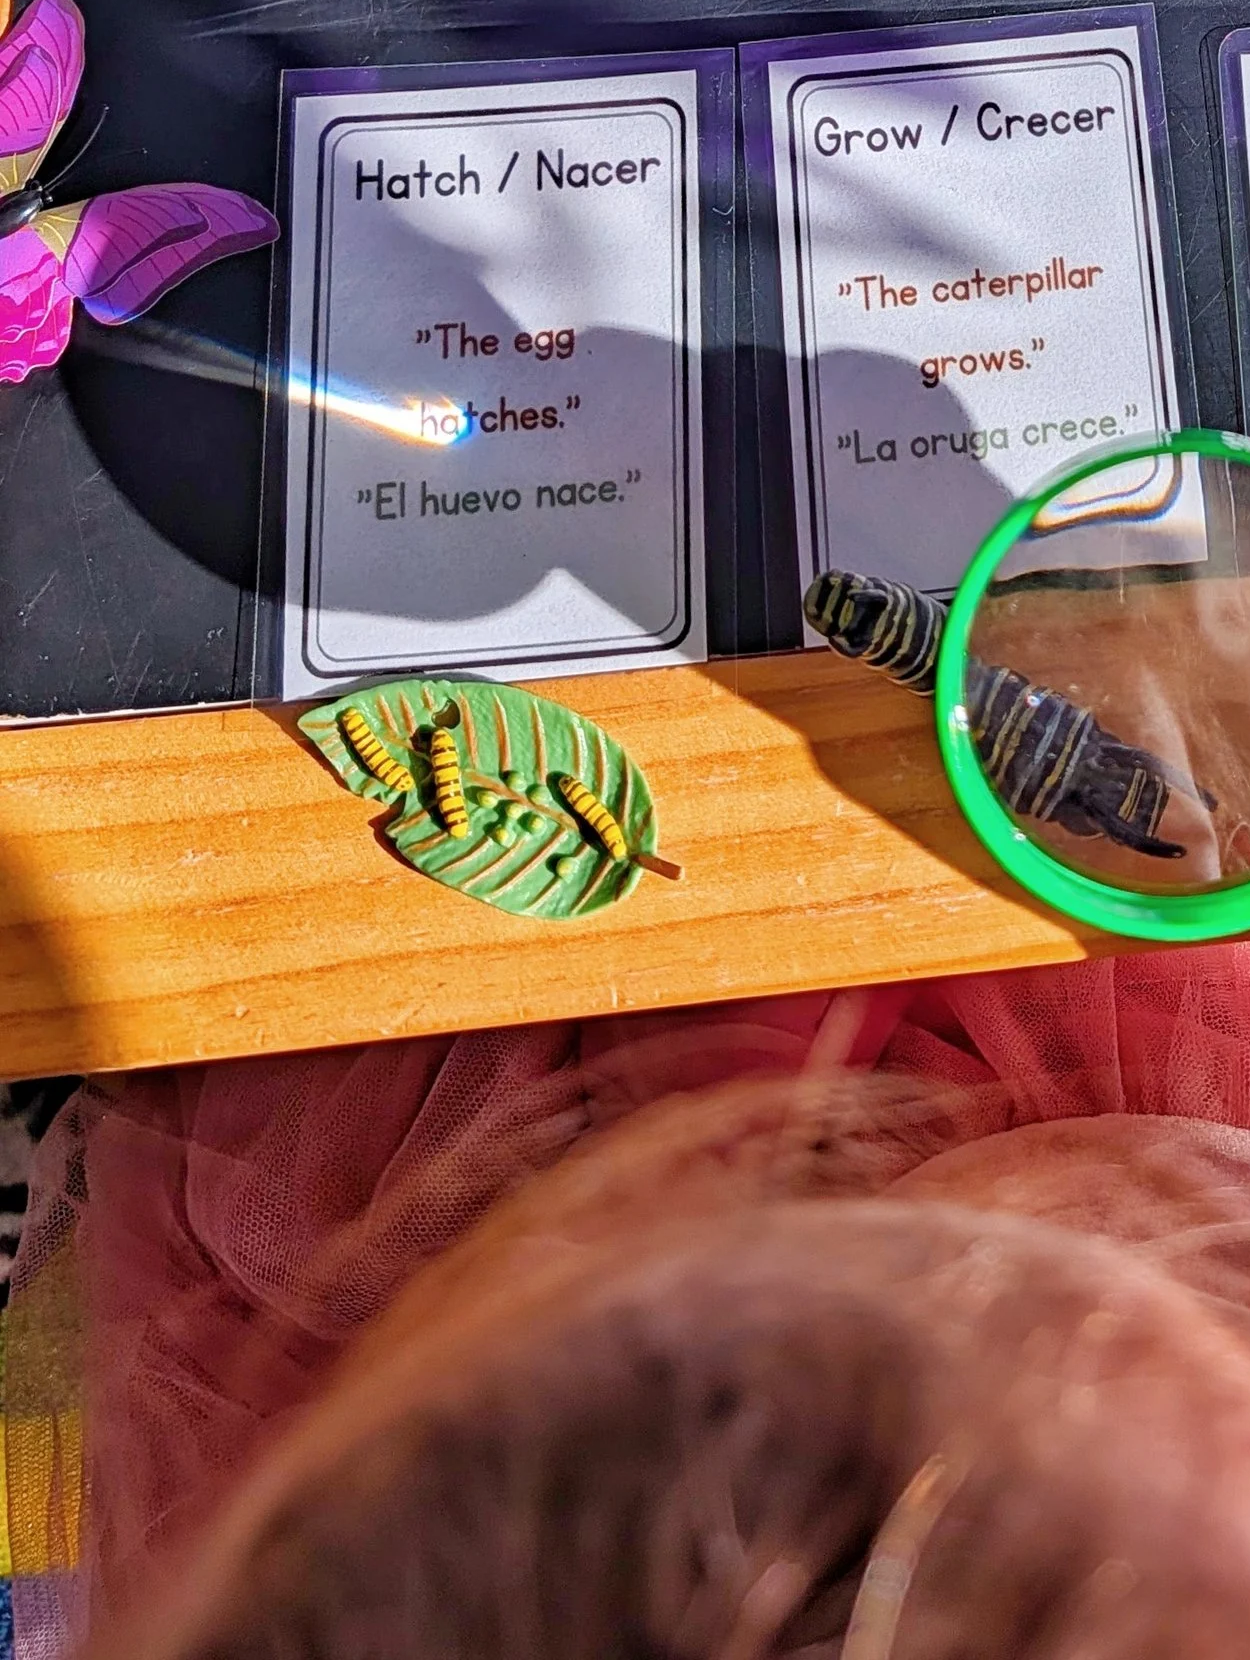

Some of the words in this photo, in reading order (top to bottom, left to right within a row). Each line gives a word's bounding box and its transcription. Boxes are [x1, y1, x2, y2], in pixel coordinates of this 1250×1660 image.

[814, 117, 922, 157] Grow
[941, 105, 959, 146] /
[977, 102, 1115, 141] Crecer
[356, 154, 481, 201] Hatch
[498, 151, 520, 193] /
[536, 148, 661, 192] Nacer
[932, 257, 1104, 304] caterpillar
[514, 328, 575, 359] egg
[920, 337, 1045, 388] grows.”
[911, 426, 1009, 461] oruga
[1022, 403, 1138, 447] crece.”
[421, 481, 521, 516] huevo
[536, 469, 641, 508] nace.”
